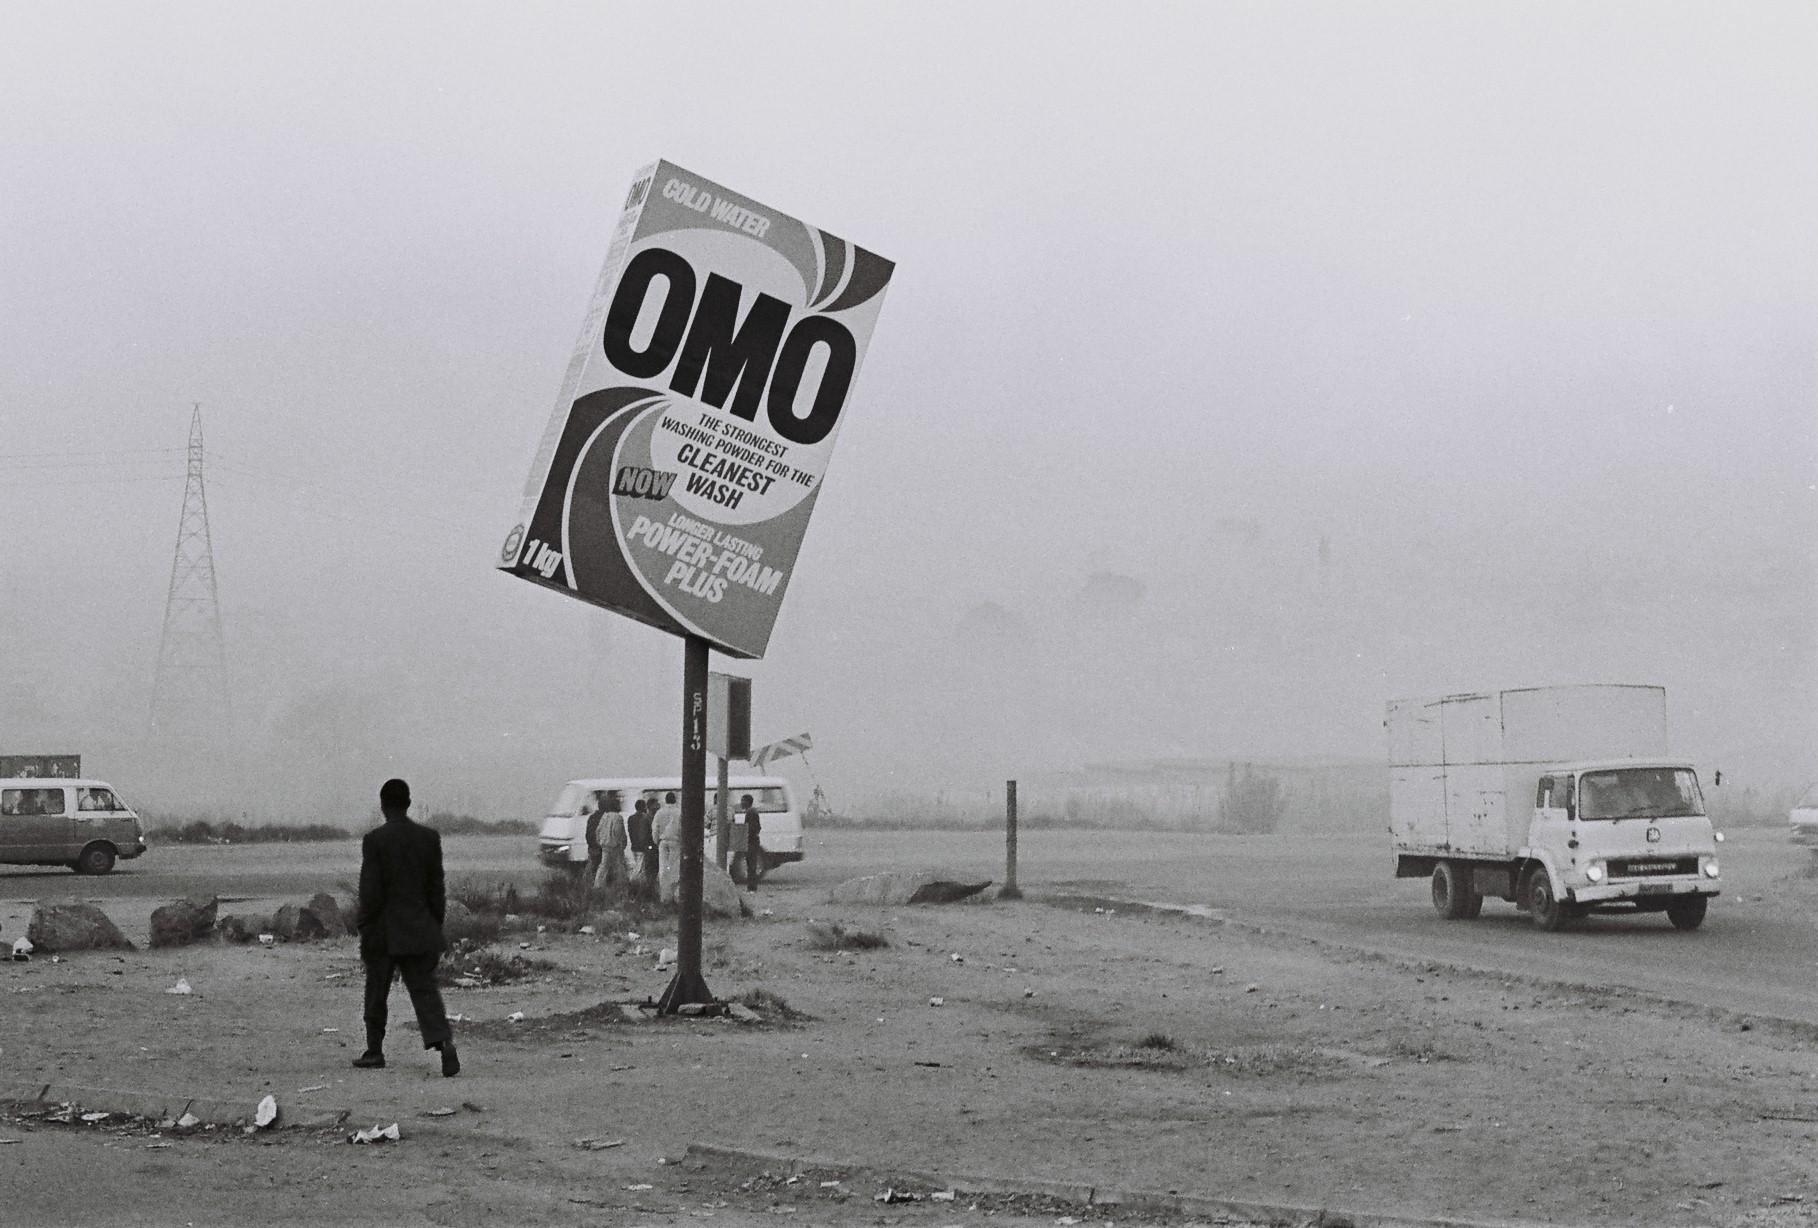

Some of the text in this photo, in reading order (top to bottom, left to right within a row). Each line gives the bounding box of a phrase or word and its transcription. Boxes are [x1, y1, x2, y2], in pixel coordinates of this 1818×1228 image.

[662, 179, 770, 238] COLD WATER
[603, 247, 857, 445] OMO
[661, 416, 816, 488] WASHING POWDER FOR THE
[698, 413, 789, 459] THE STRONGEST
[612, 466, 678, 501] NOW
[677, 443, 776, 496] CLEANEST
[685, 472, 744, 510] WASH
[626, 515, 784, 596] POWER-FOAM
[667, 512, 765, 561] LONGER LASTING
[663, 560, 729, 604] PLUS
